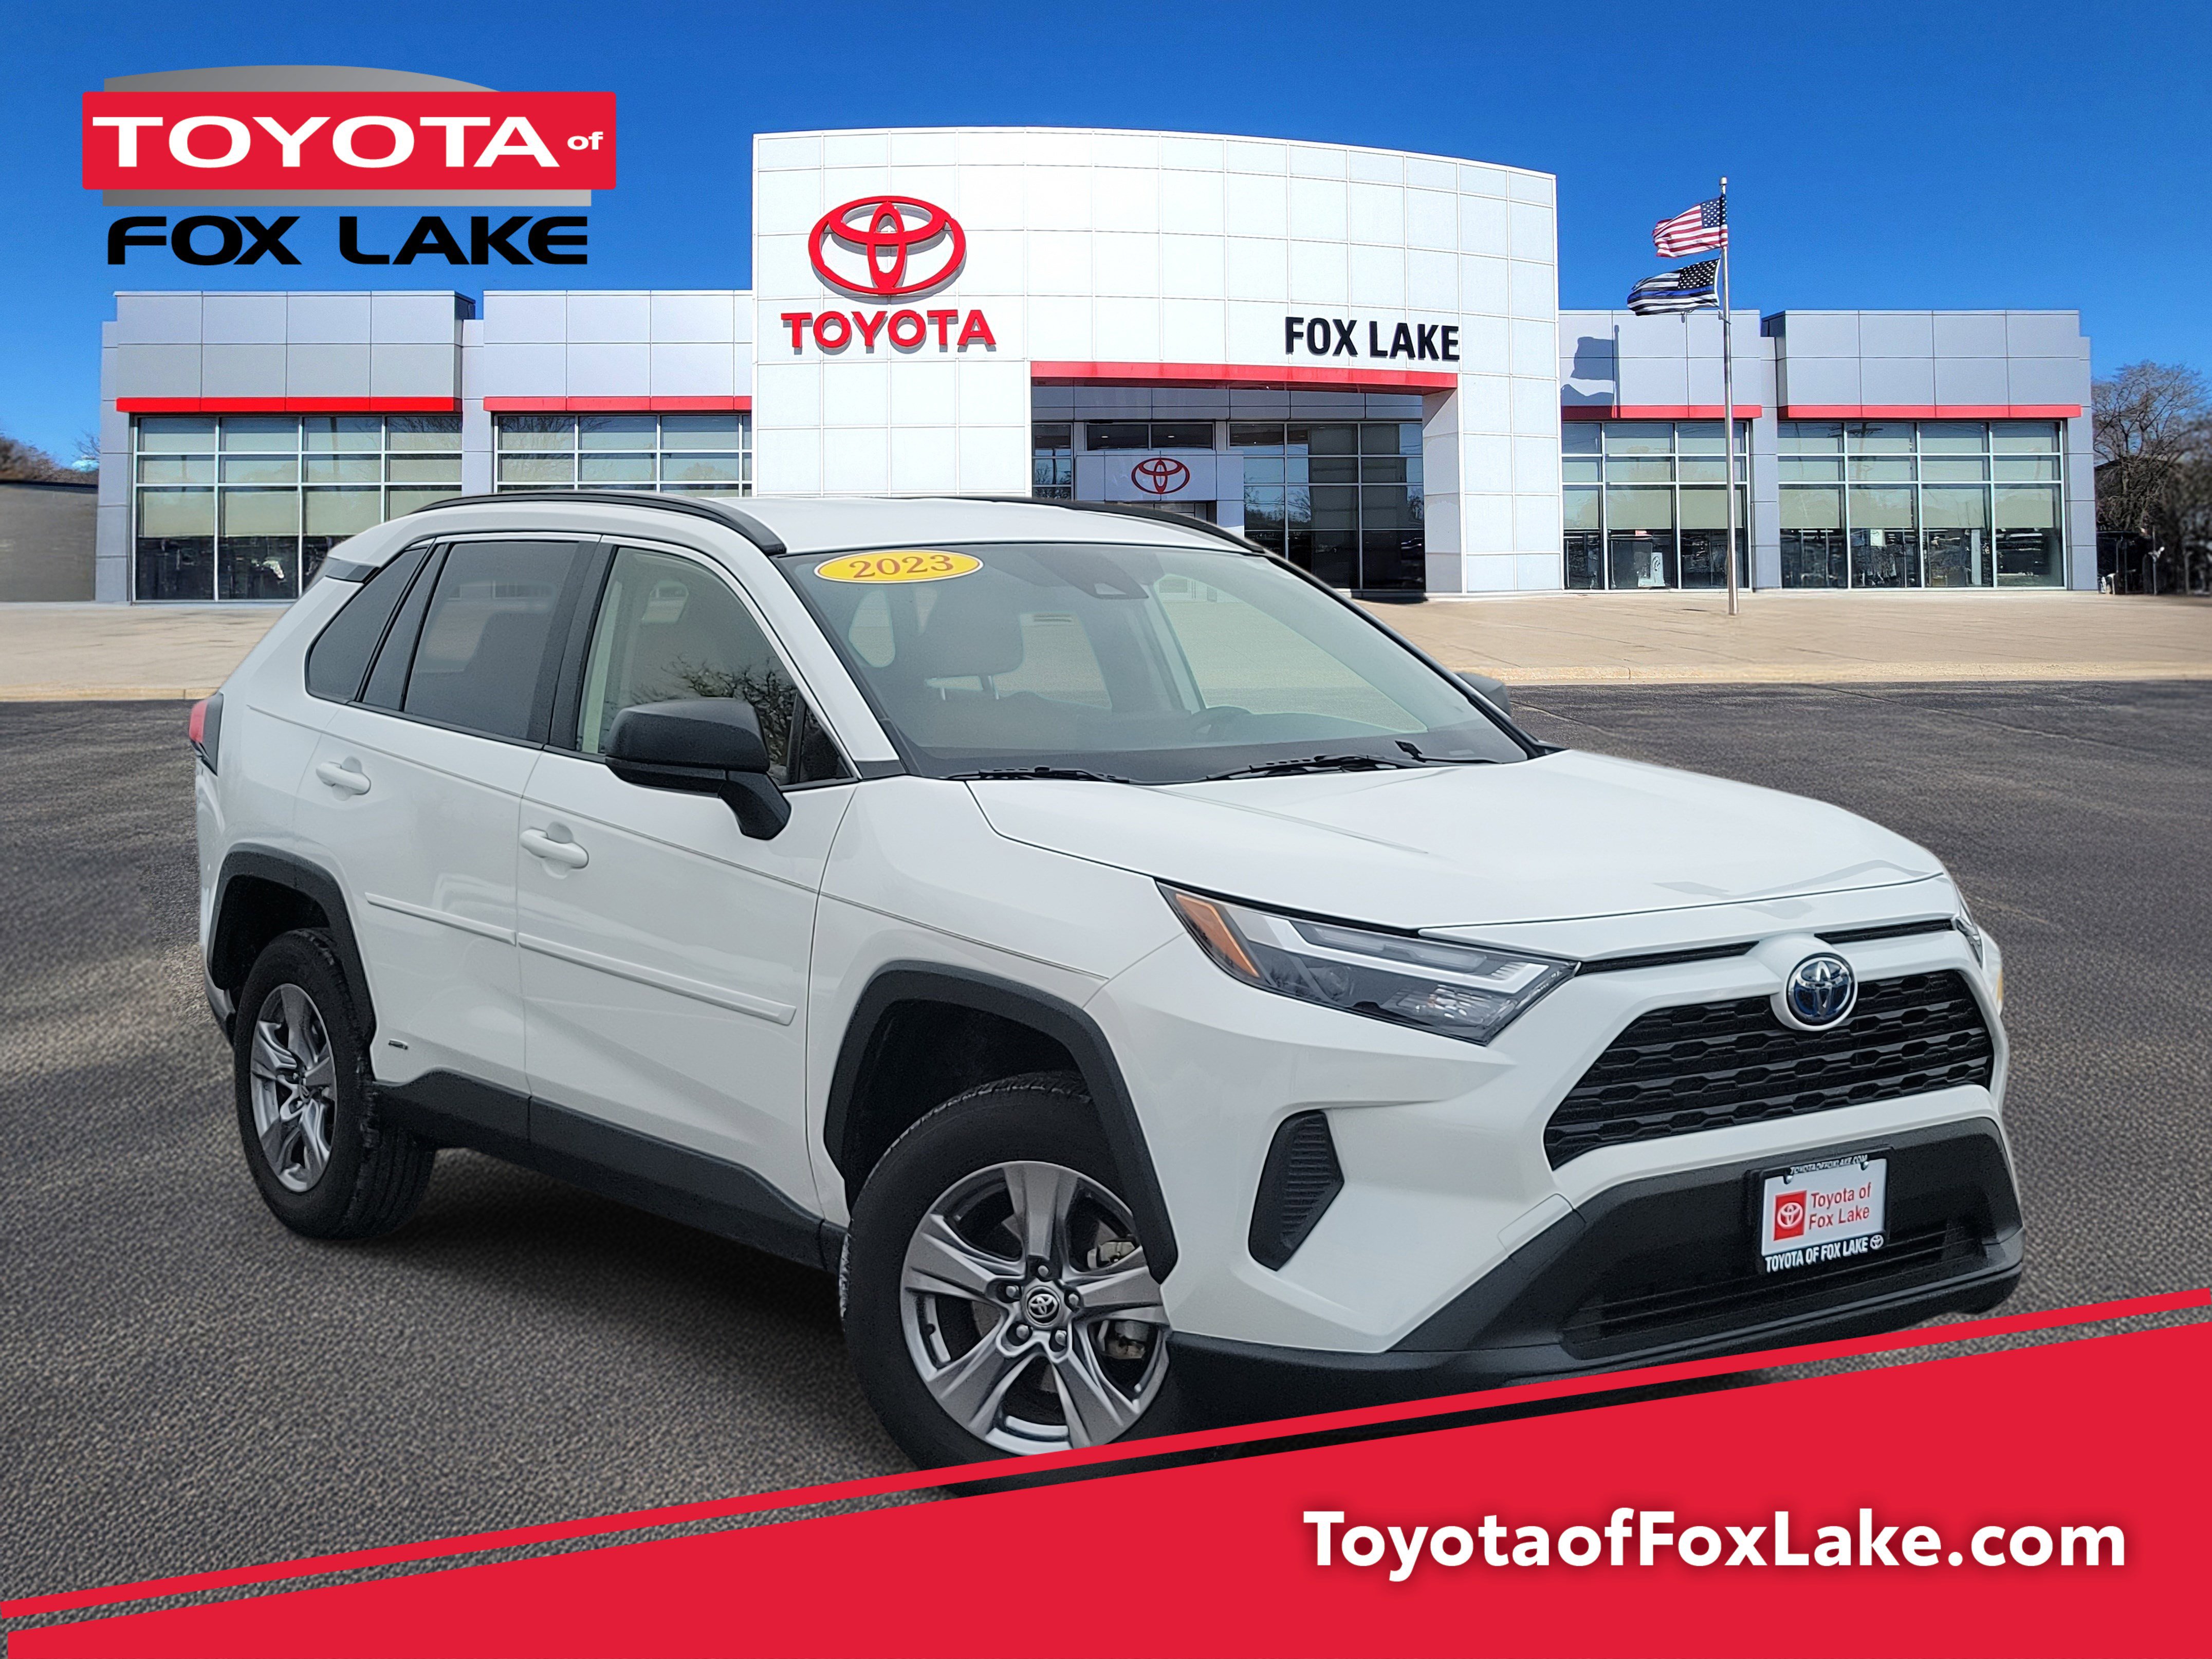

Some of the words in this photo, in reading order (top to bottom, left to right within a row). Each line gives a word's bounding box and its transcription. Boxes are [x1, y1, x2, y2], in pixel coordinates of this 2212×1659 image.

[781, 309, 997, 351] TOYOTA
[1285, 316, 1358, 358] FOX
[1369, 321, 1461, 361] LAKE
[849, 555, 954, 579] 2023
[1811, 1188, 1855, 1210] Toyota
[1859, 1182, 1872, 1199] of
[1809, 1213, 1834, 1230] Fox
[1838, 1205, 1870, 1224] Lake
[1765, 1251, 1804, 1274] TOYOTA
[1805, 1246, 1819, 1265] OF
[1820, 1241, 1841, 1262] FOX
[1842, 1237, 1869, 1256] LAKE
